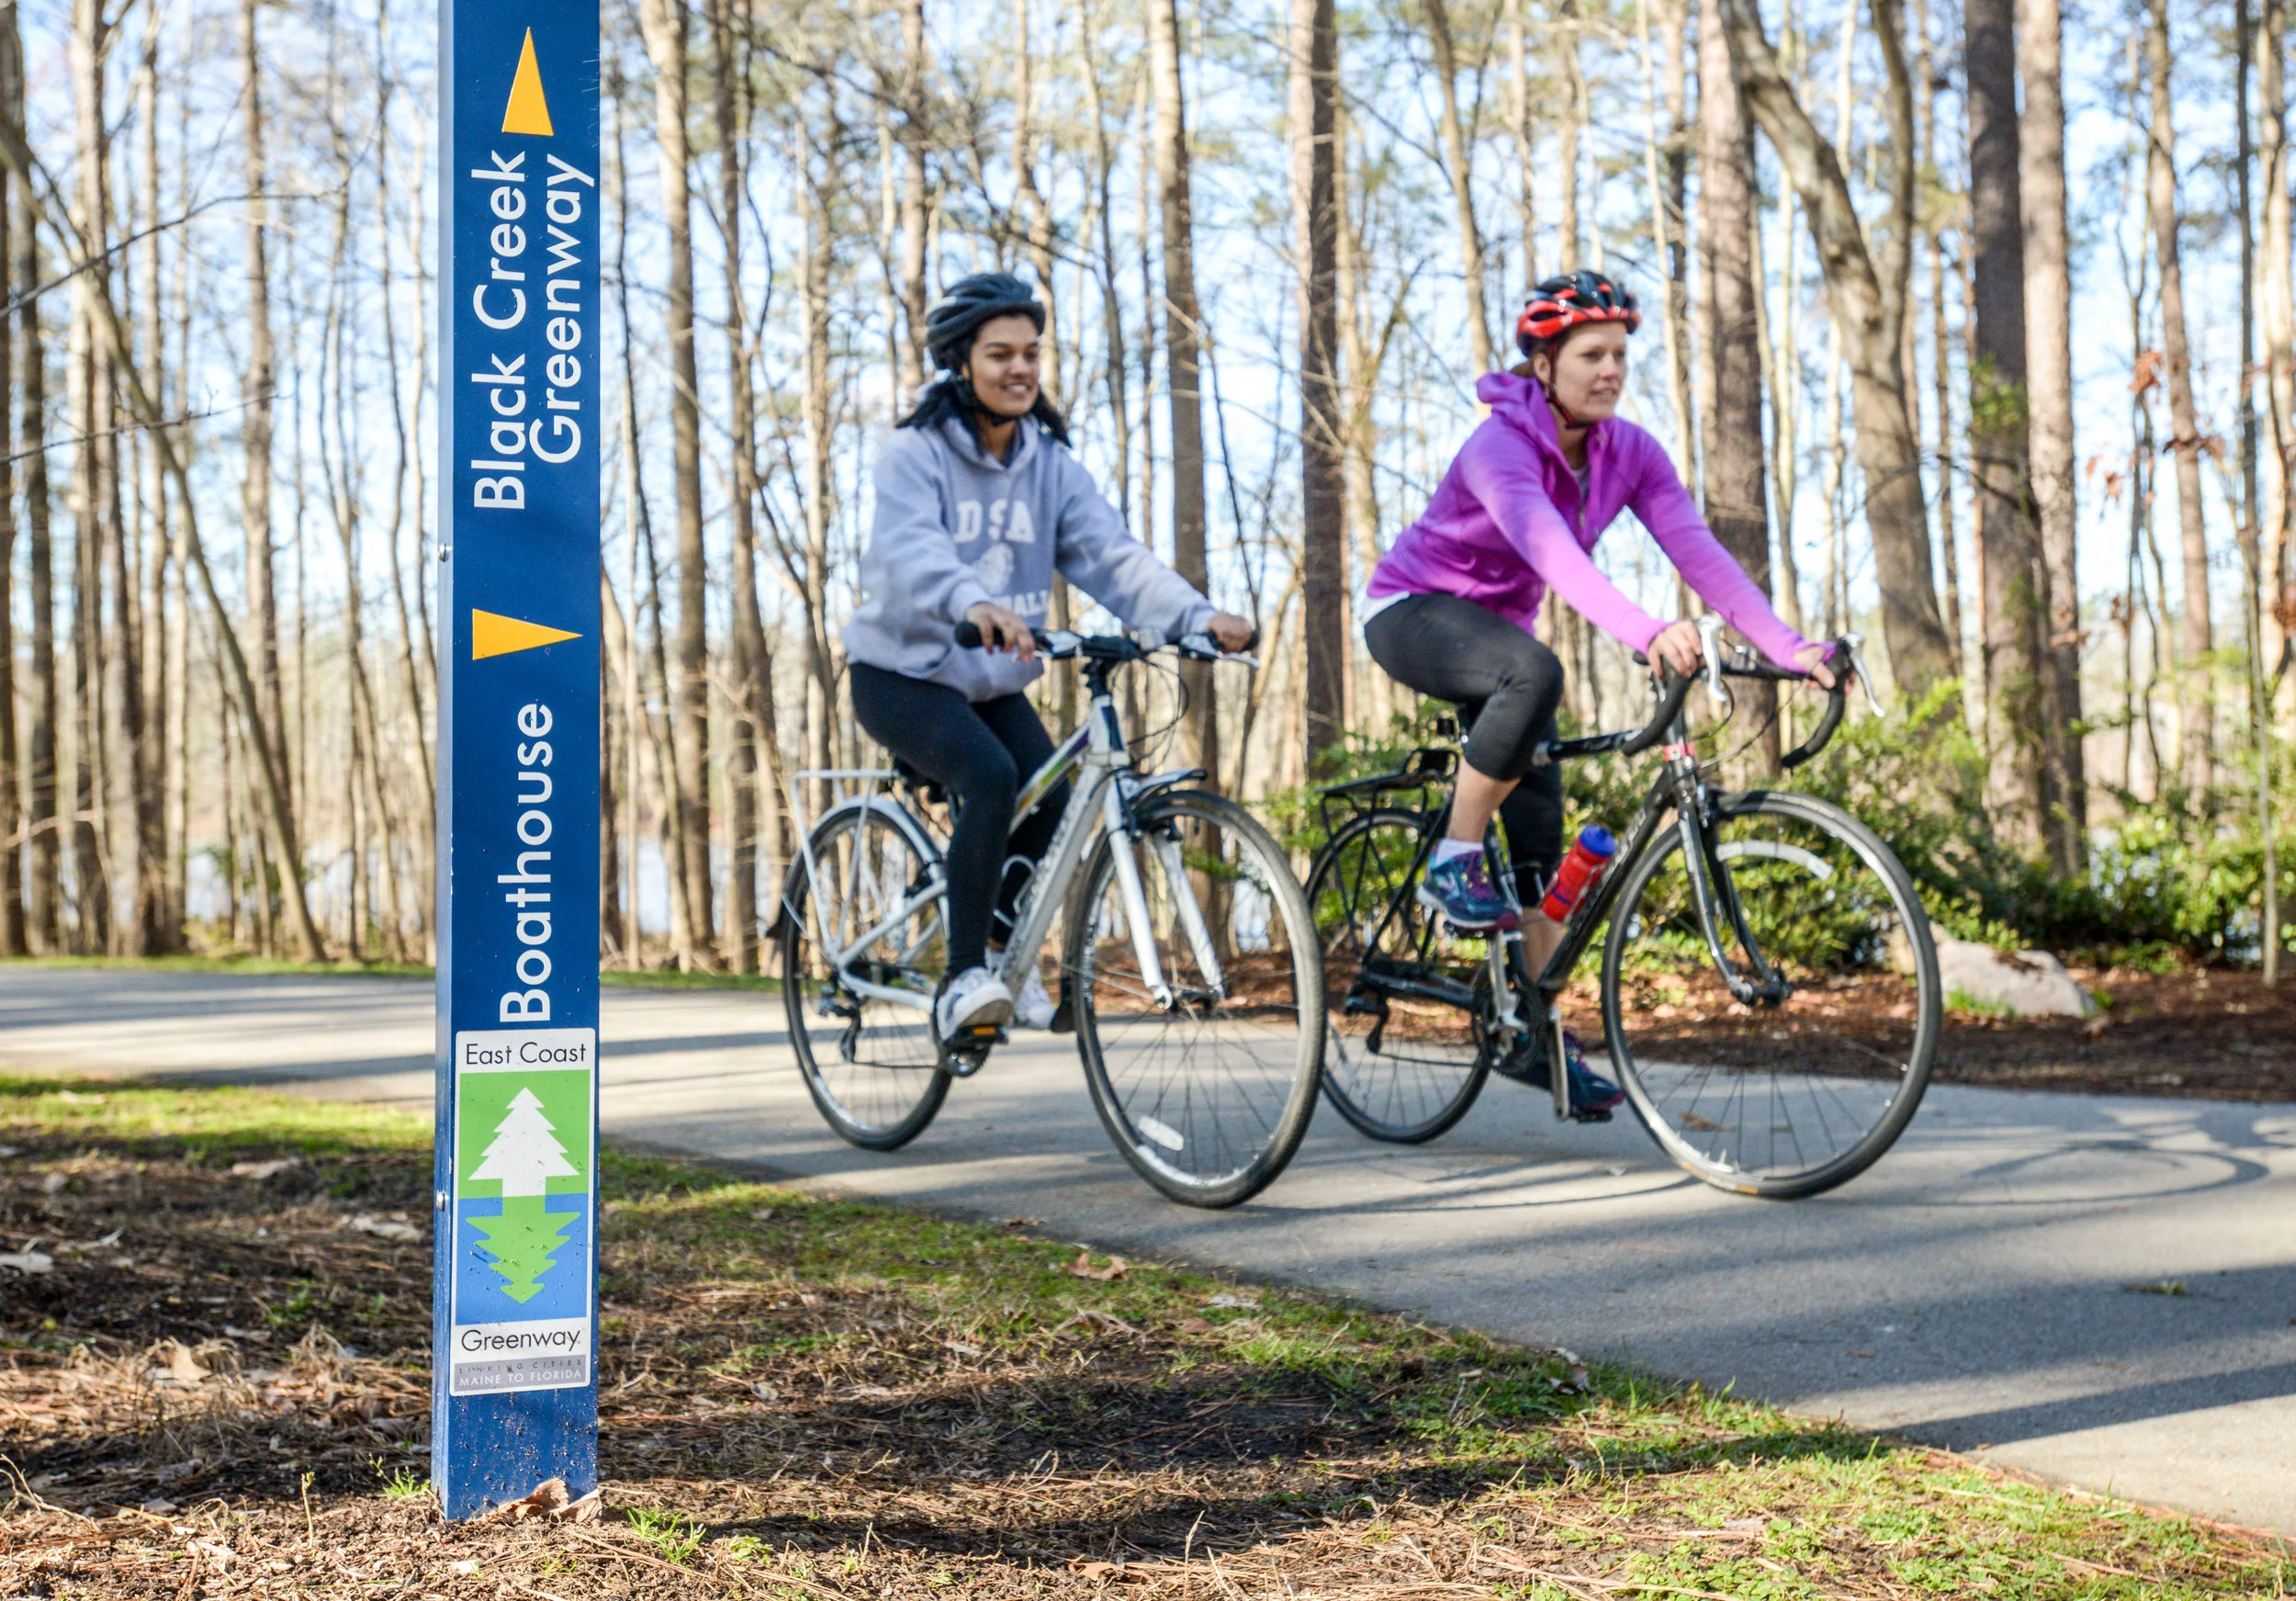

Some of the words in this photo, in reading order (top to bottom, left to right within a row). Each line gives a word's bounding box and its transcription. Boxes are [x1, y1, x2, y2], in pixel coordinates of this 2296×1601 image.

[471, 150, 526, 330] Creek
[529, 153, 595, 464] Greenway
[471, 353, 526, 510] Black
[497, 704, 553, 1022] Boathouse
[466, 1043, 512, 1065] East
[520, 1042, 587, 1064] Coast
[459, 1374, 501, 1387] MAINE
[508, 1372, 523, 1383] TO
[530, 1369, 581, 1381] FLORIDA
[461, 1329, 580, 1352] Greenway
[533, 1359, 581, 1369] CITIES
